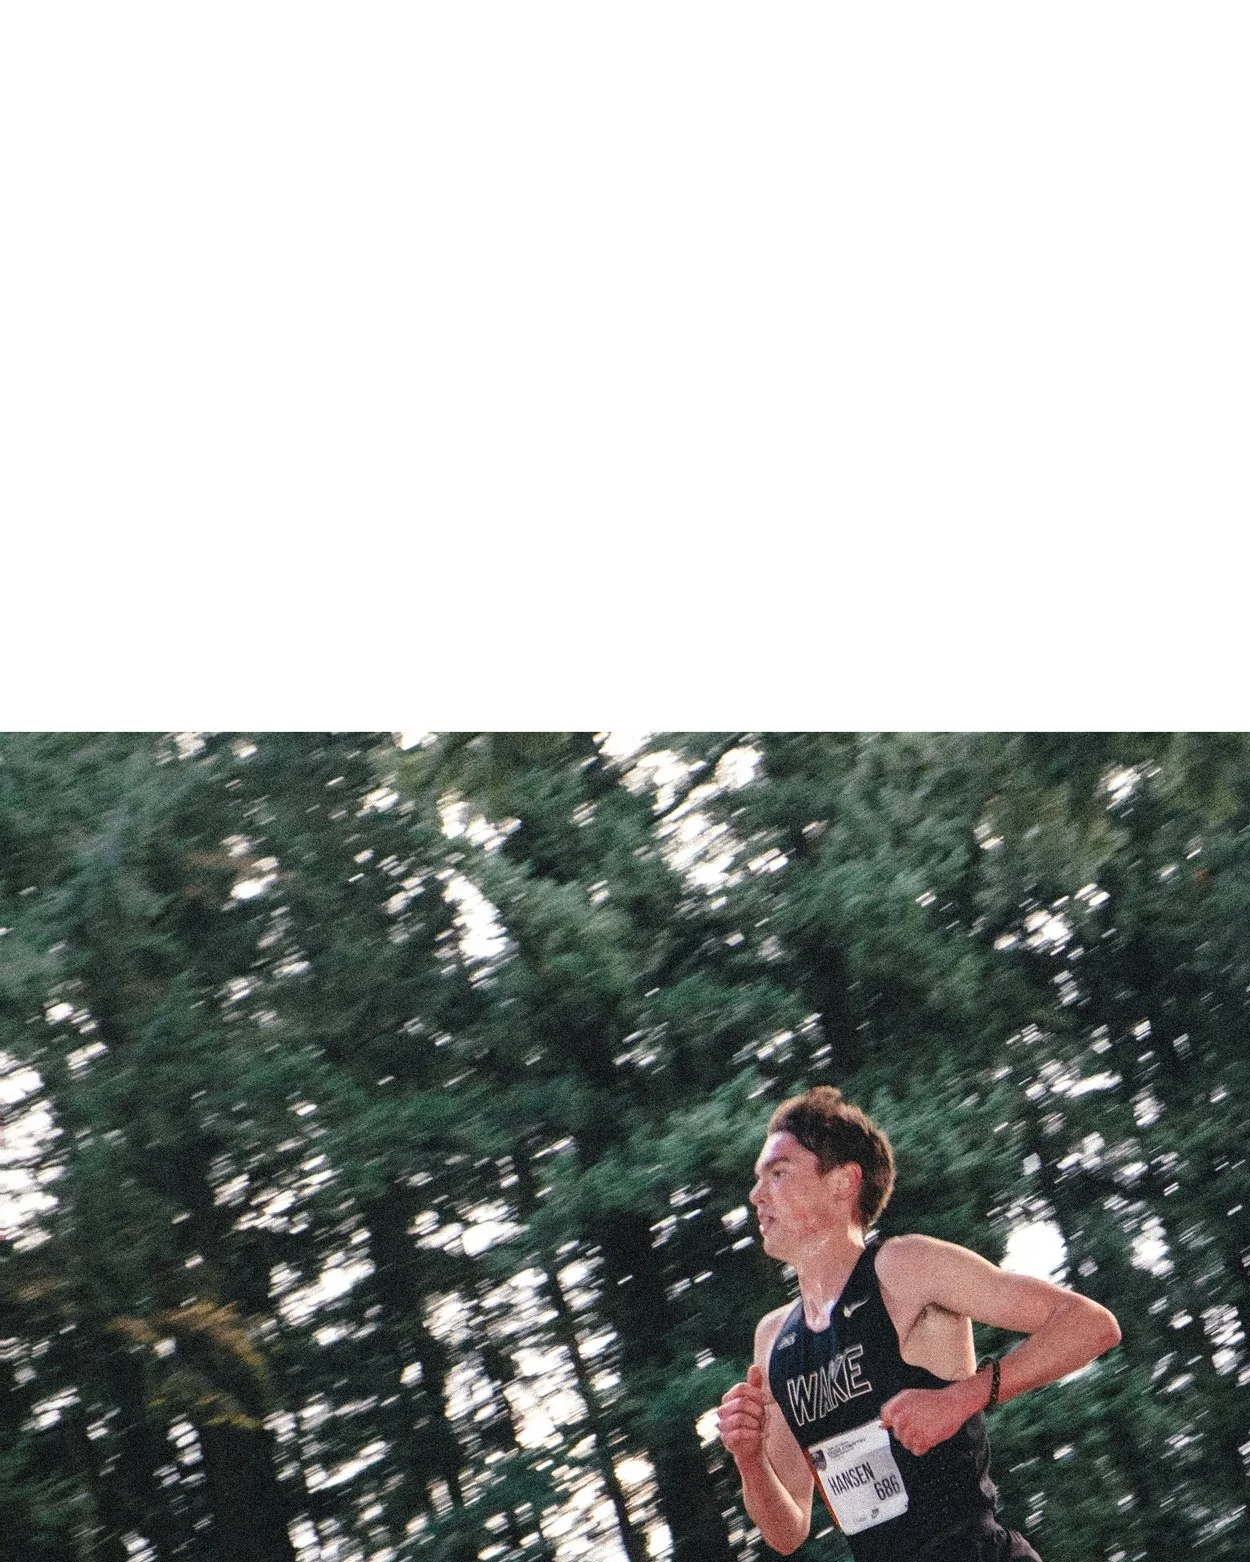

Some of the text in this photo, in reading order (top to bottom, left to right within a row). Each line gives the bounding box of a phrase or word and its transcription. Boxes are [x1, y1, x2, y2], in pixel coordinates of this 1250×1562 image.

[787, 1344, 872, 1426] WAKE
[828, 1462, 875, 1495] HANSEN
[874, 1475, 900, 1500] 686
